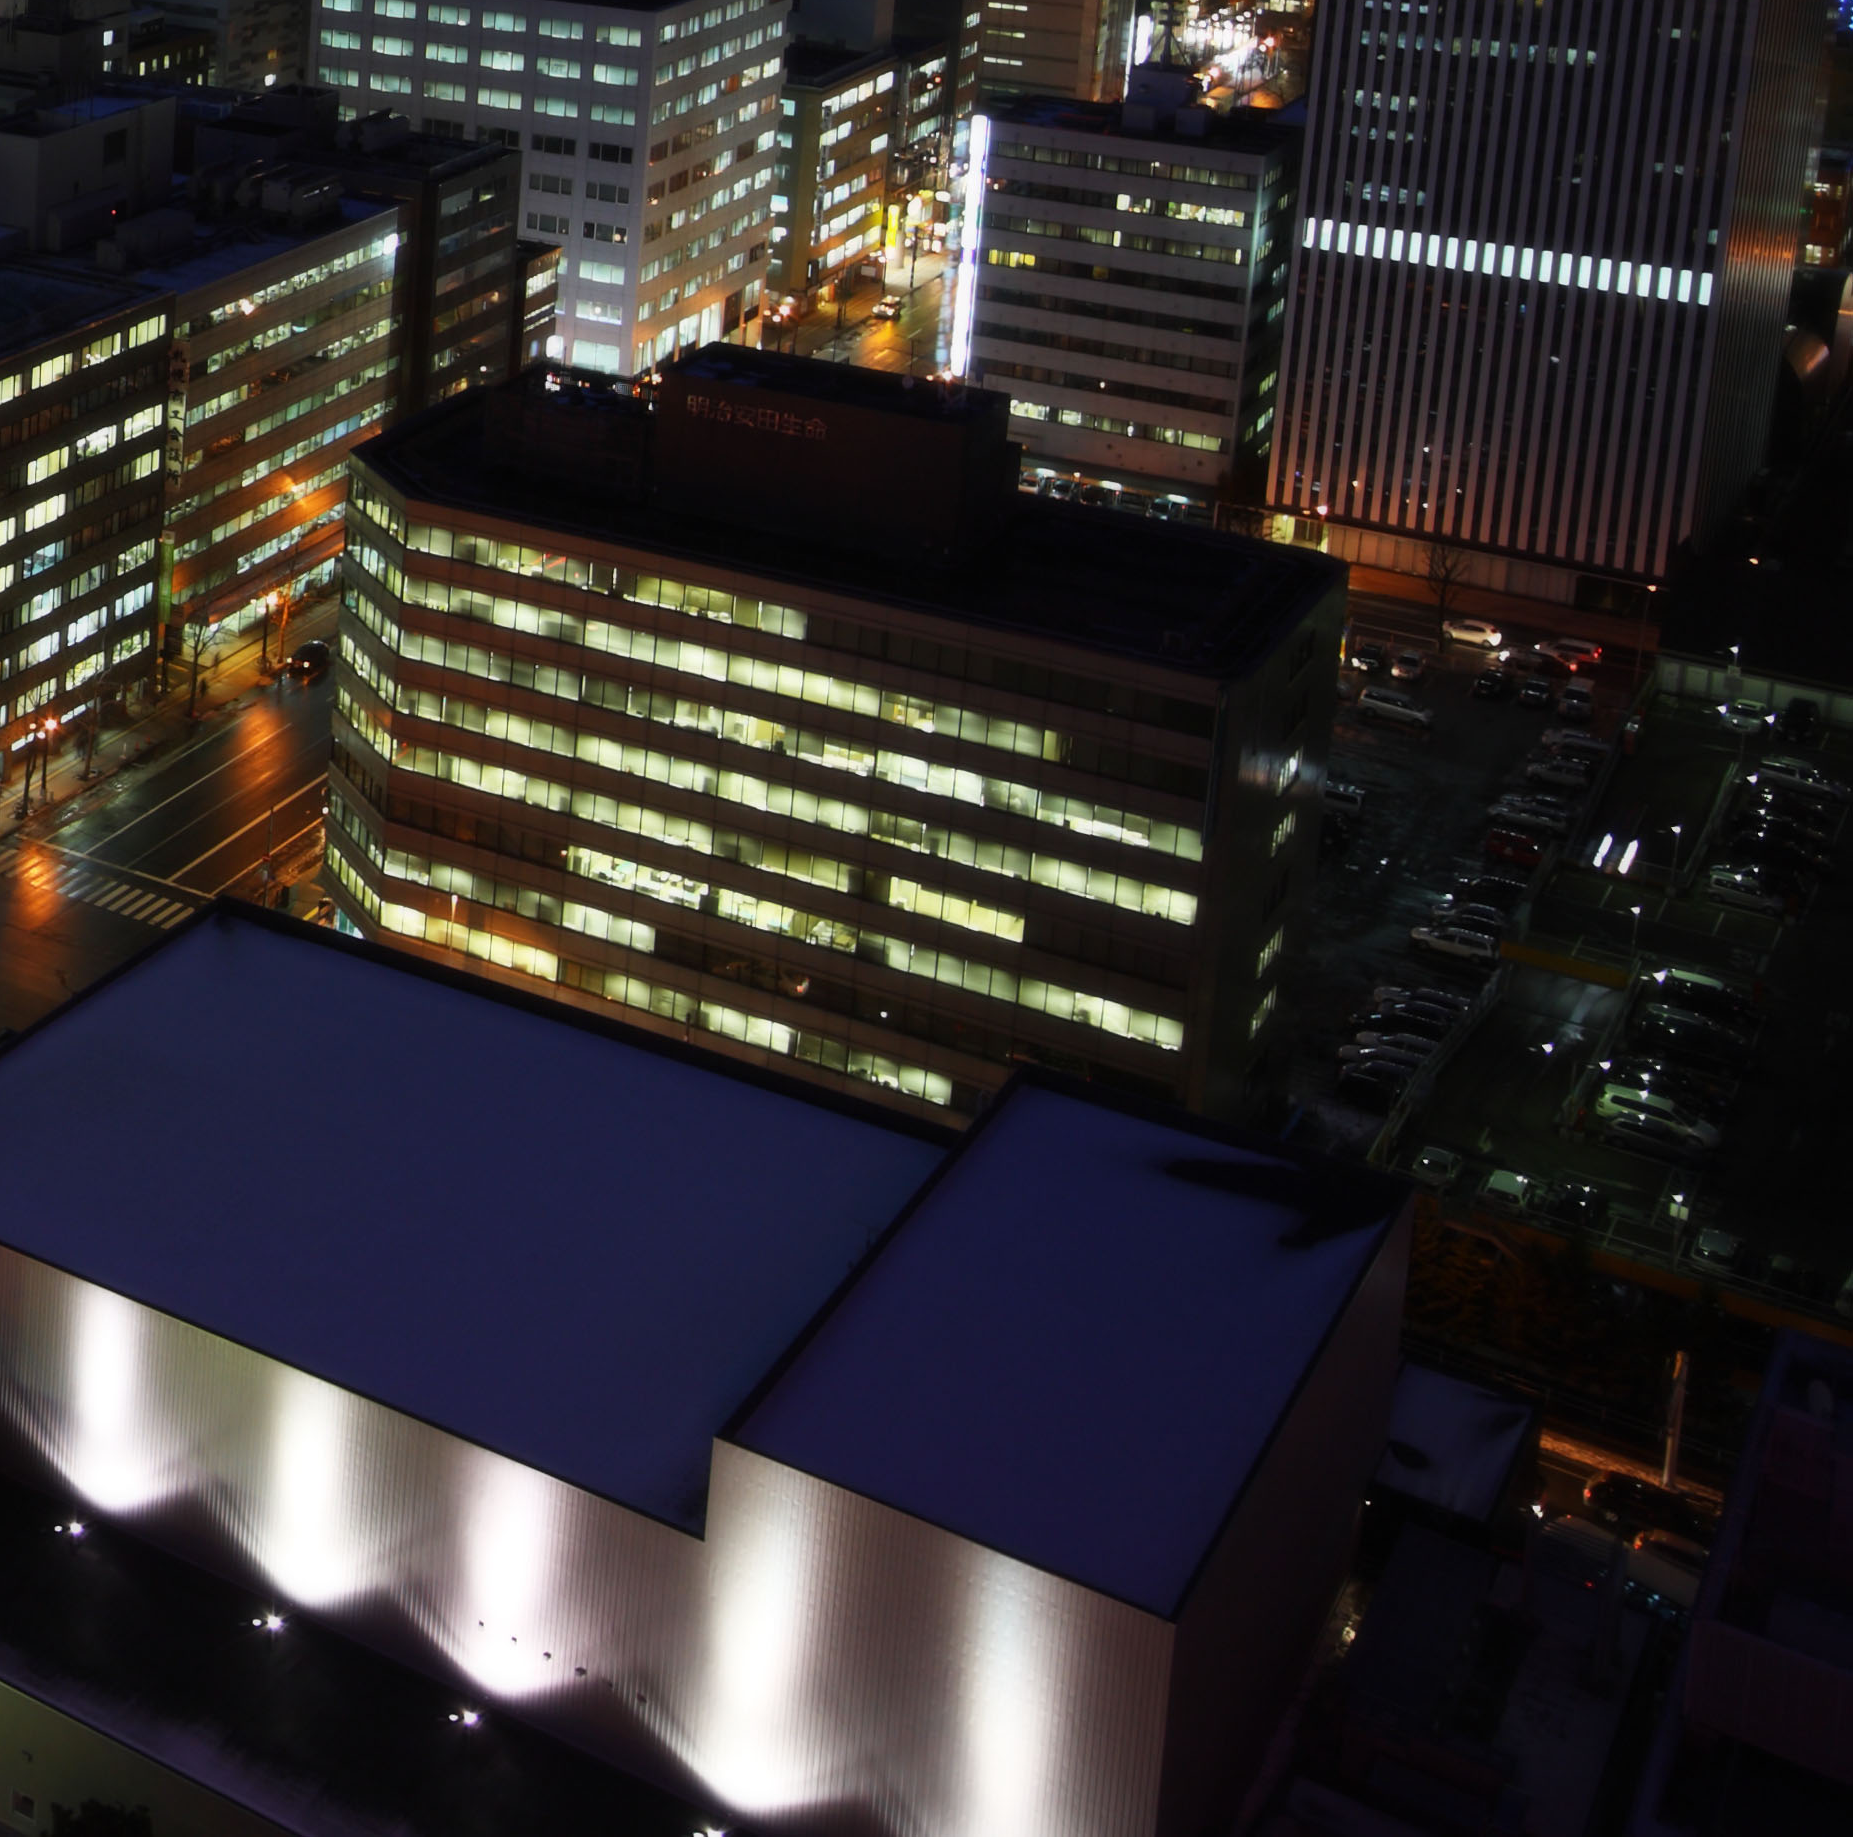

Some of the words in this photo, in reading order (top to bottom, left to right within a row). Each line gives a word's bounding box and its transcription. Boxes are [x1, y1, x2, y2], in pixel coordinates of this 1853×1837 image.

[686, 393, 829, 442] 明治安田生命
